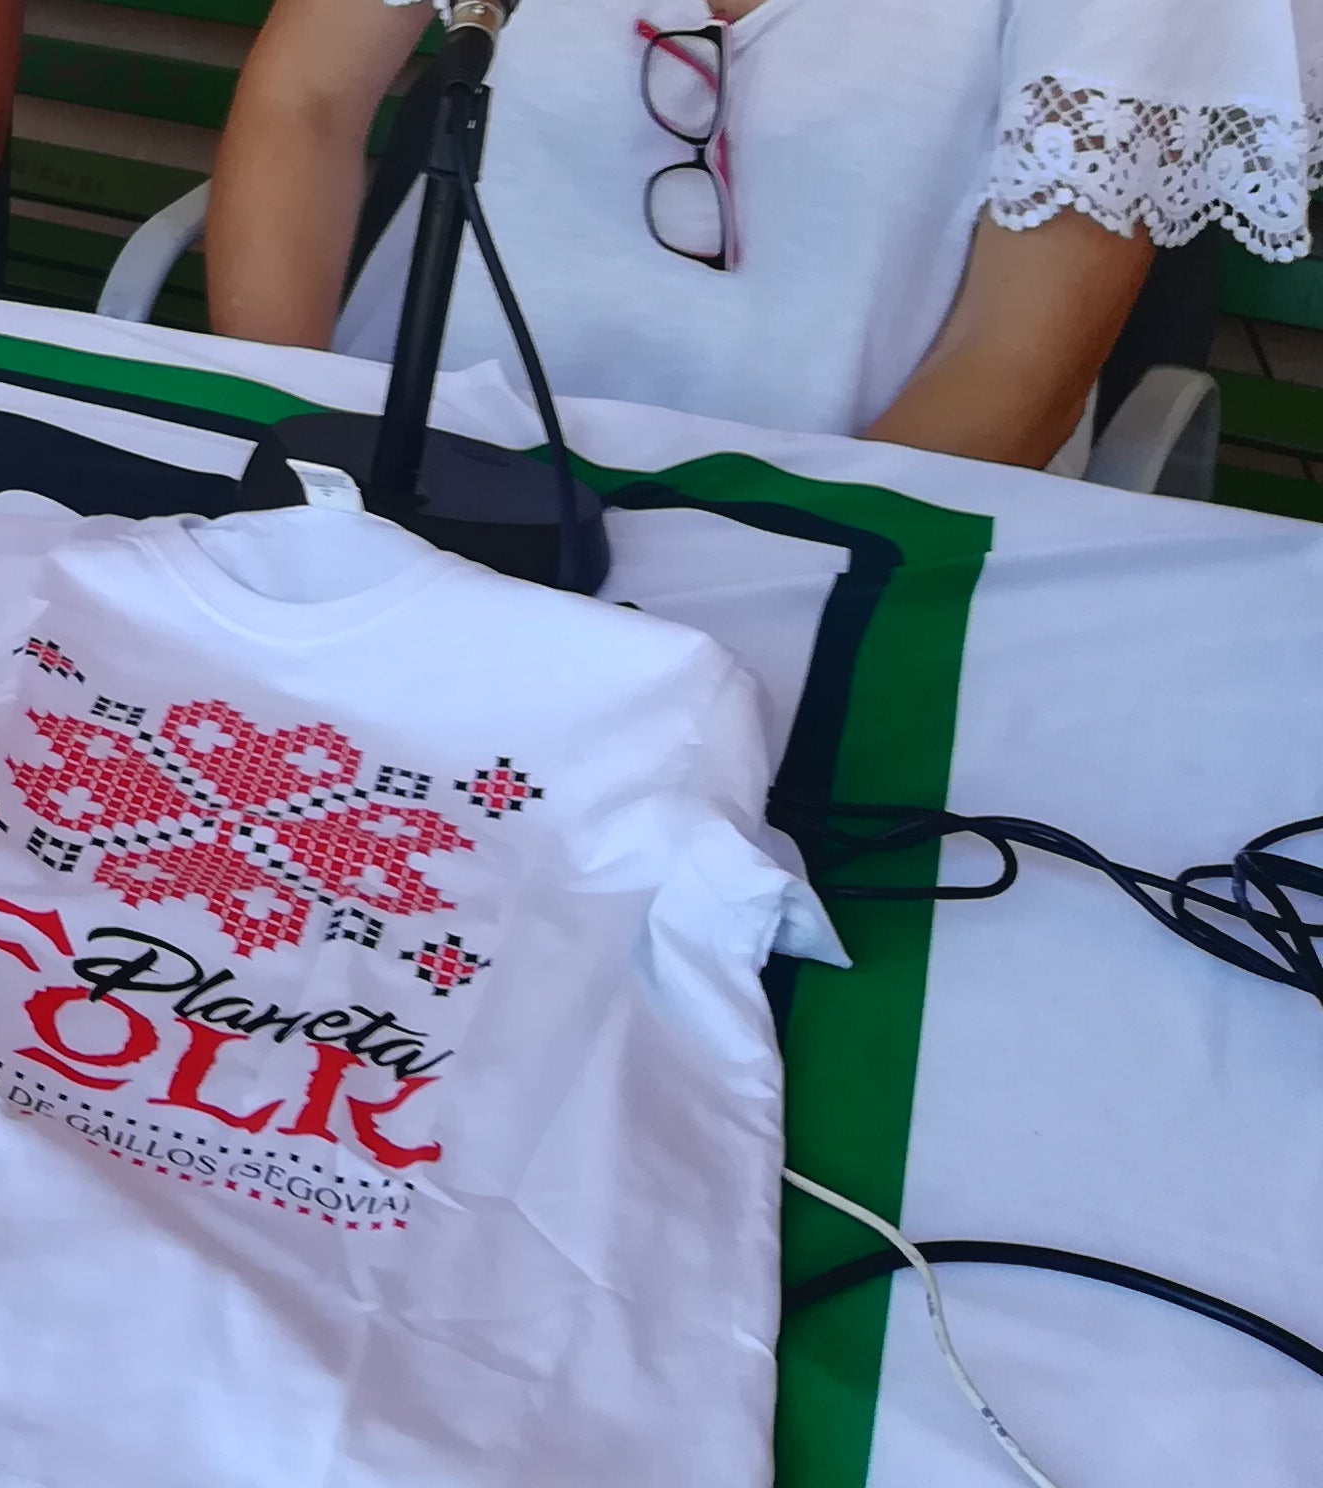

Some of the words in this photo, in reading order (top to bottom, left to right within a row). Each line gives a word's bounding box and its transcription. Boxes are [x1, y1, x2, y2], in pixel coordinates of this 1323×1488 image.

[71, 927, 454, 1082] Planeta
[7, 1085, 57, 1119] DE
[65, 1113, 218, 1177] GAILLOS
[227, 1160, 412, 1216] (SEGOVIA)
